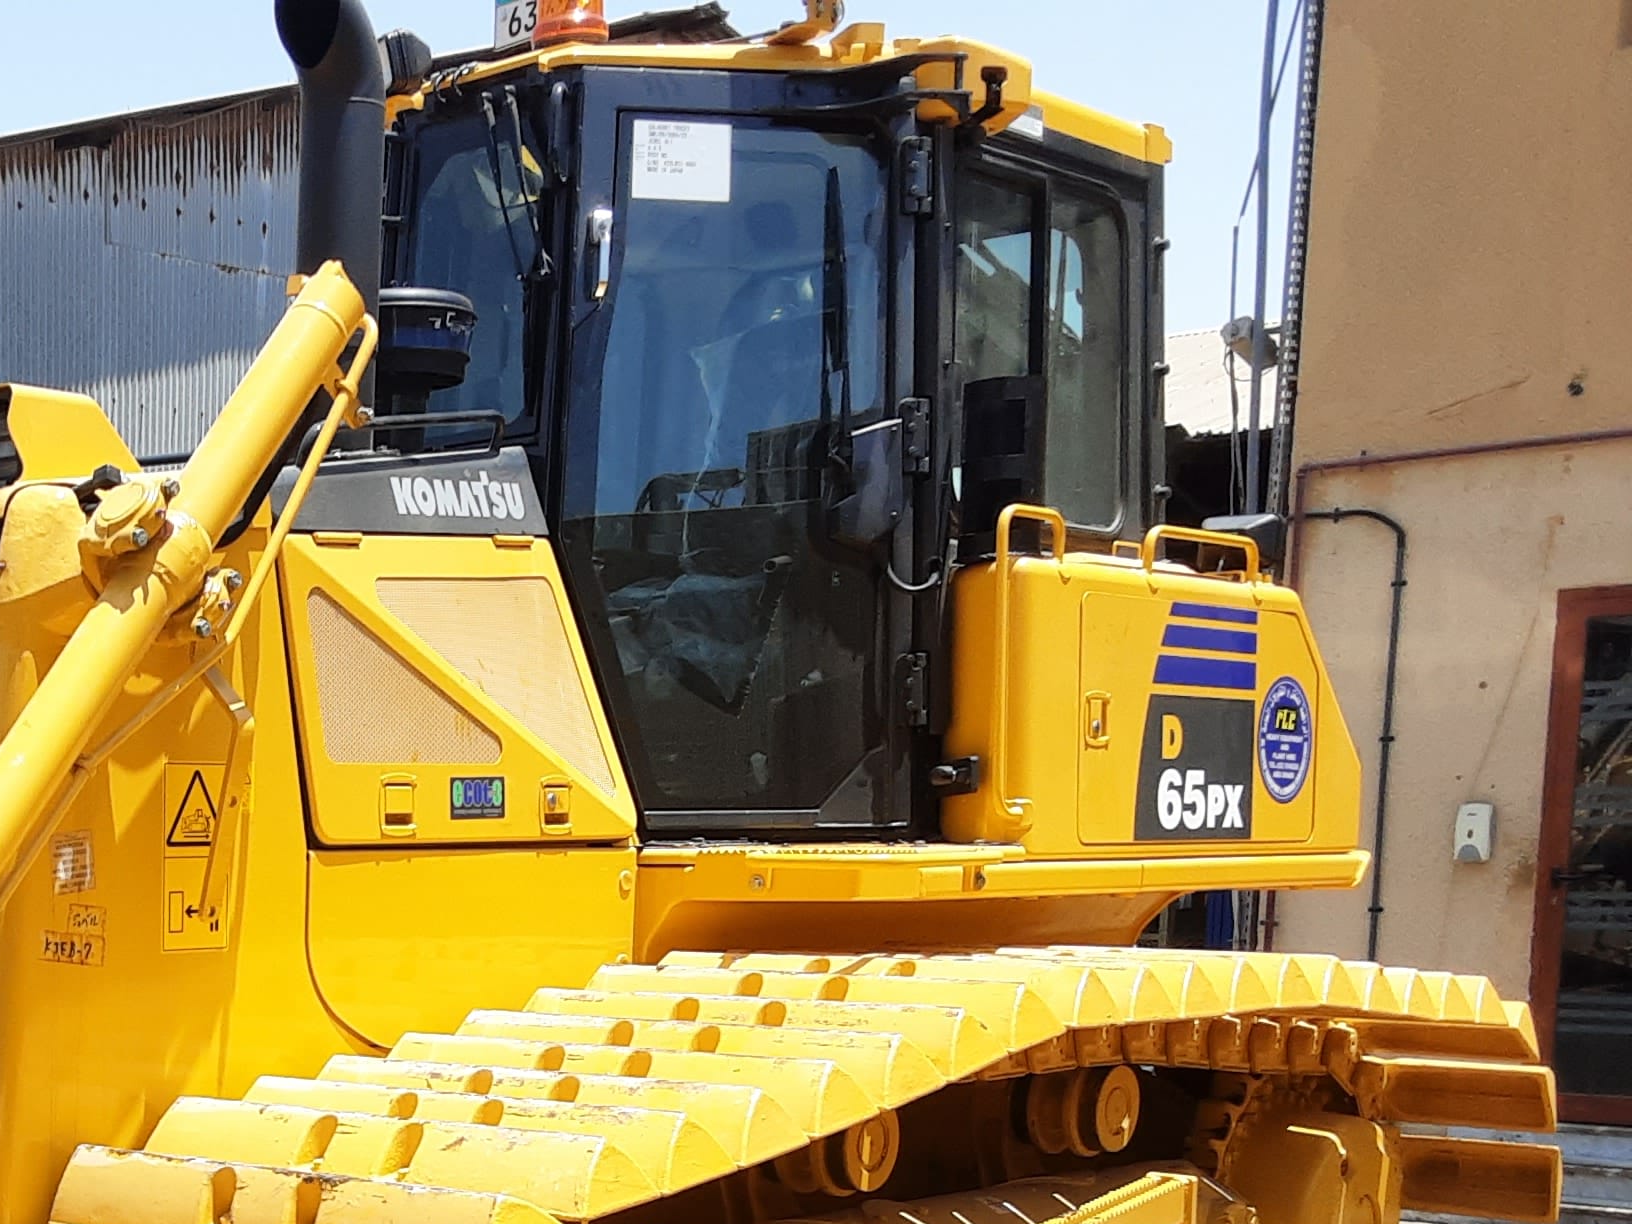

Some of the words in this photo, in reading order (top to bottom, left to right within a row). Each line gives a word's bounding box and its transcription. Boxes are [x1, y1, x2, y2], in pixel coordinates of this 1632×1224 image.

[390, 470, 525, 520] KOMATSU
[1161, 715, 1184, 760] D
[1157, 768, 1244, 830] 65PX
